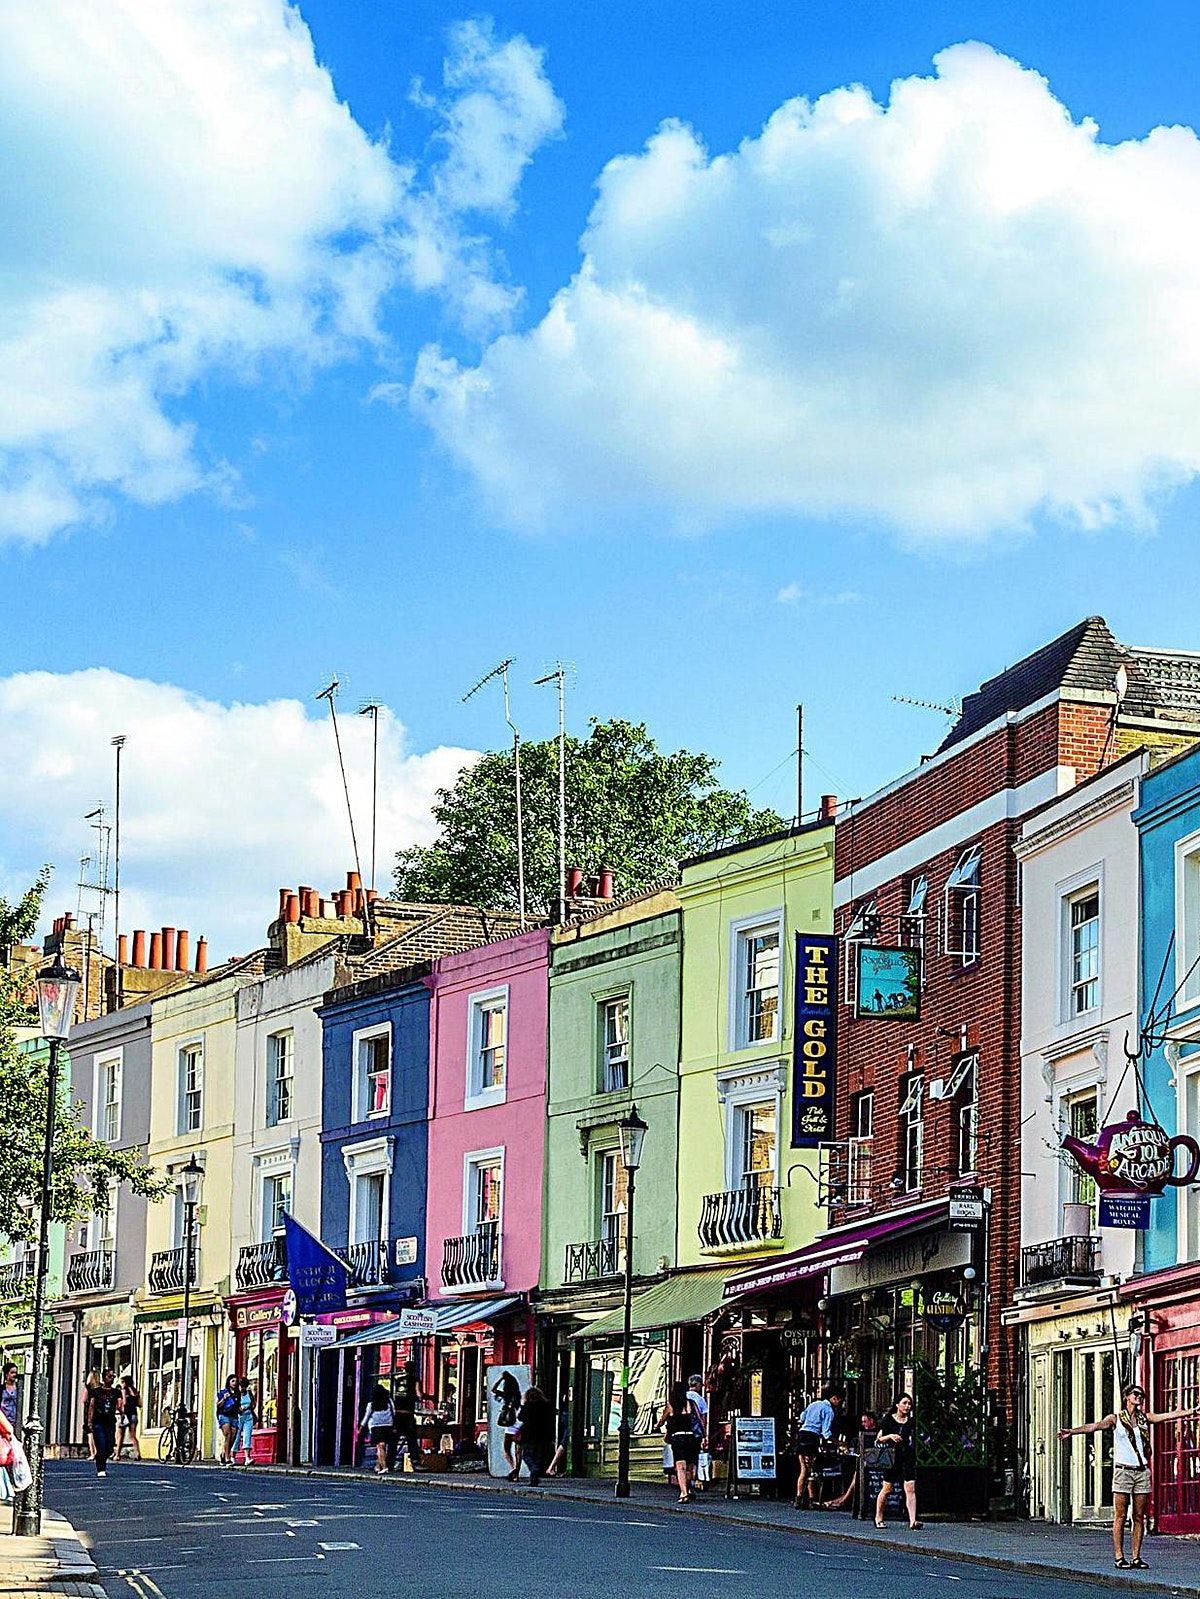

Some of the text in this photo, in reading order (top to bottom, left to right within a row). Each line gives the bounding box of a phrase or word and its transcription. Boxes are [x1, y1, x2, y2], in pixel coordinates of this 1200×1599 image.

[804, 946, 829, 1005] THE
[802, 1019, 828, 1098] GOLD
[1140, 1145, 1160, 1162] 101
[1113, 1155, 1170, 1180] ARCADE
[1109, 1211, 1141, 1219] MUSICAL
[932, 1291, 959, 1308] Gallery
[784, 1329, 817, 1338] OYSTER
